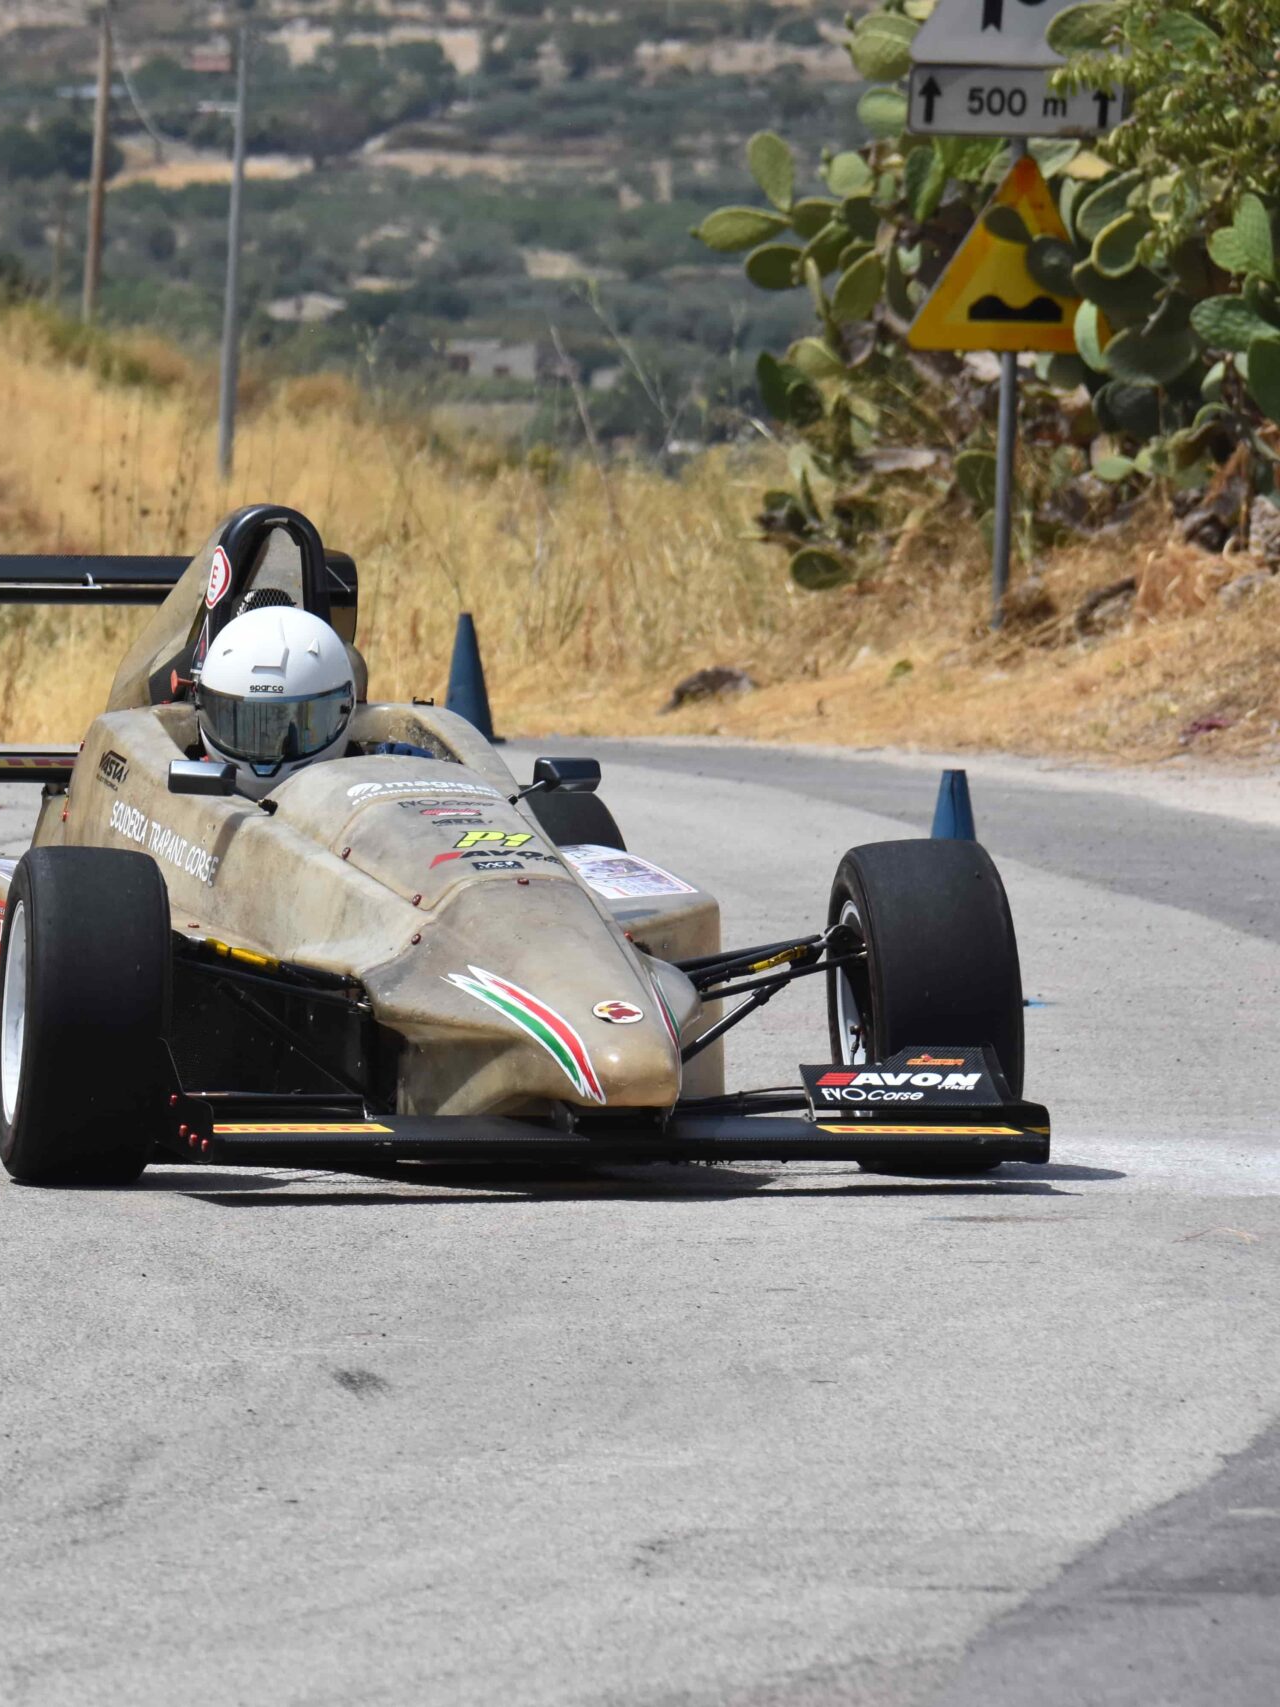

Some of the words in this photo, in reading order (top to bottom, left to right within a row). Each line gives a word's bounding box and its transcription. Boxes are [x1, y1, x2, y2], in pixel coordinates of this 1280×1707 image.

[968, 86, 1026, 116] 500
[1042, 96, 1068, 117] m
[249, 685, 284, 694] sparco
[110, 799, 149, 845] SCUDERIA
[148, 821, 187, 867] TRAPANI
[185, 846, 219, 888] CORSE
[452, 831, 534, 848] P1
[850, 1073, 982, 1087] AVON
